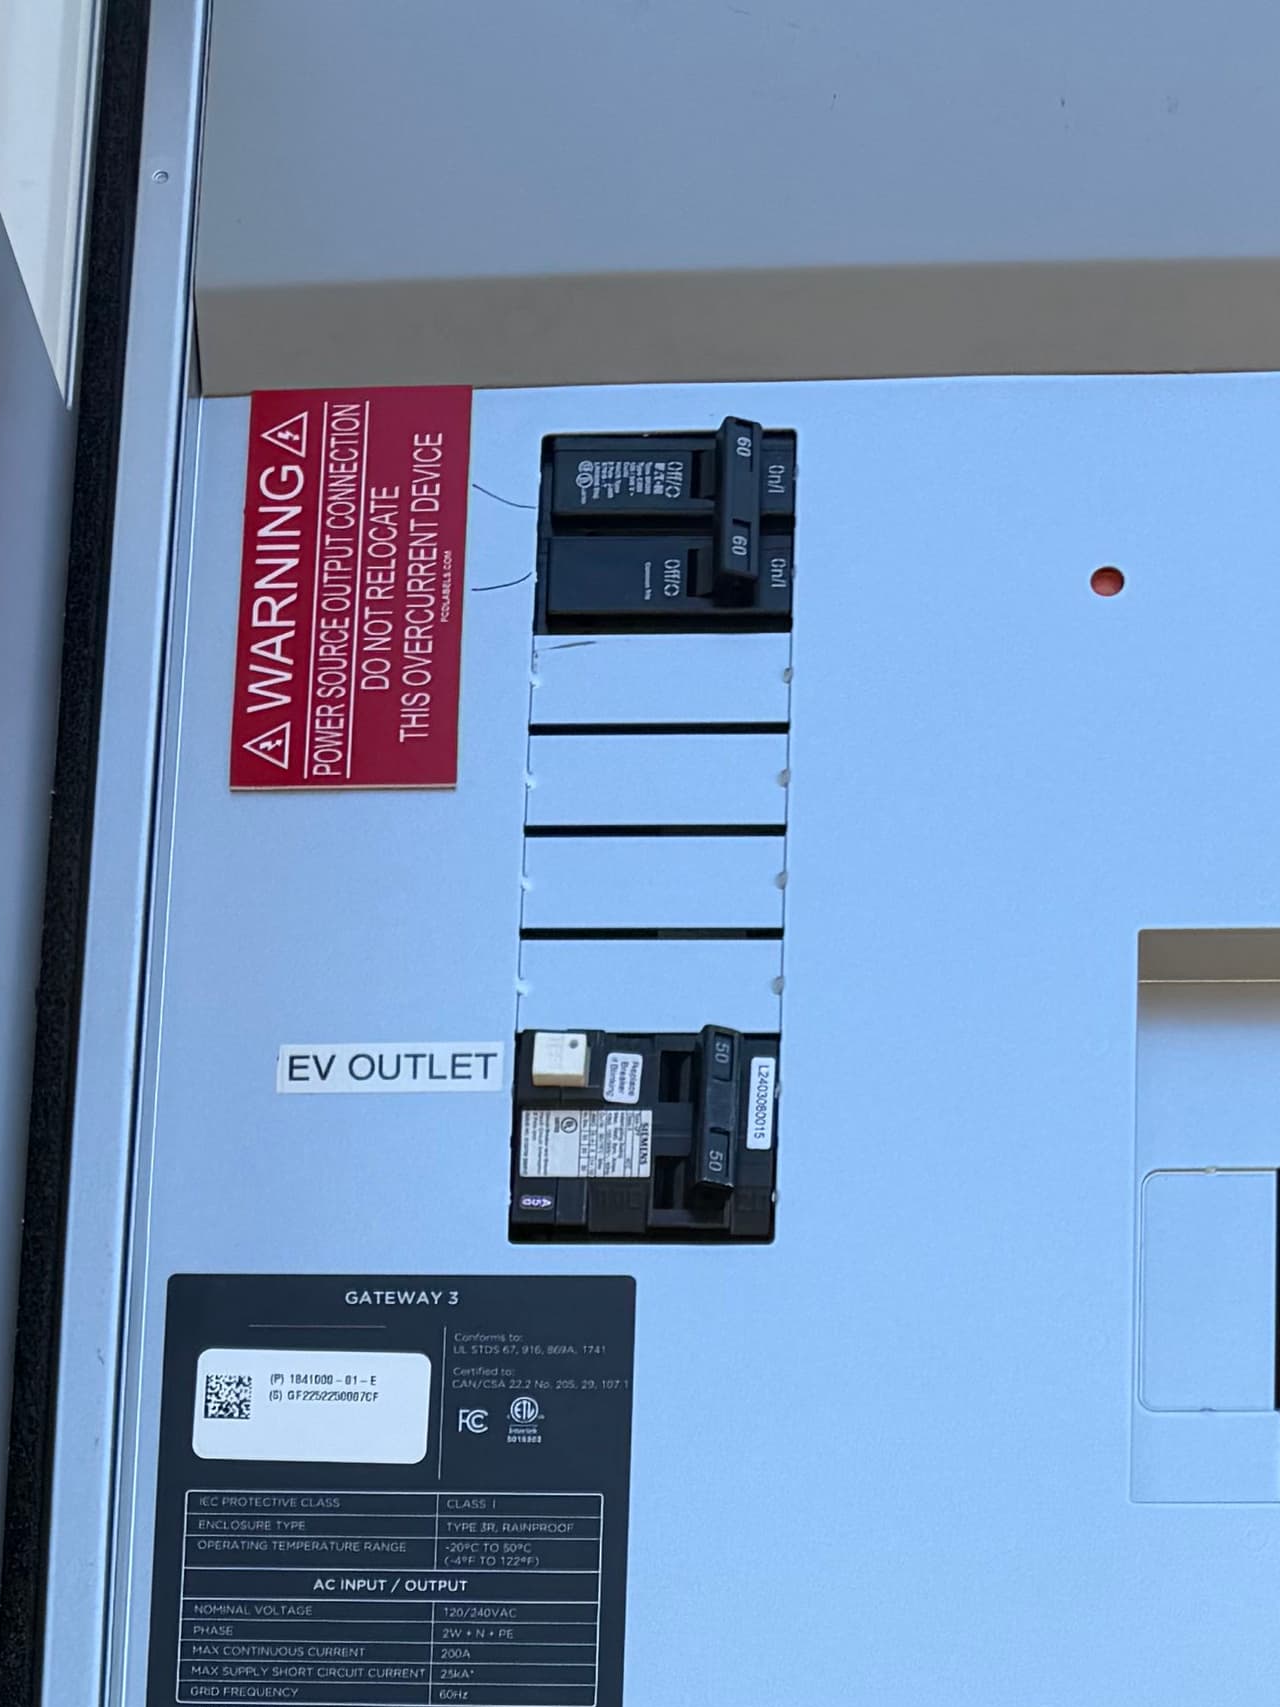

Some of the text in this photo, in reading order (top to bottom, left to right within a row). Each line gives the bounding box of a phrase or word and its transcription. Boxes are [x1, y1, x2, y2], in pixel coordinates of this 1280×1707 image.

[736, 436, 752, 458] 60
[732, 535, 748, 556] 60
[246, 465, 304, 713] WARNING
[312, 404, 361, 775] POWER SOURCE OUTPUT CONNECTION
[360, 486, 399, 690] DO NOT RELOCATE
[399, 433, 443, 743] THIS OVERCURRENT DEVICE
[715, 1043, 730, 1064] 50
[288, 1053, 498, 1081] EV OUTLET
[640, 1122, 649, 1165] SIEMENS
[708, 1150, 724, 1172] 50
[345, 1291, 458, 1305] GATEWAY 3
[313, 1578, 468, 1593] AC INPUT / OUTPUT
